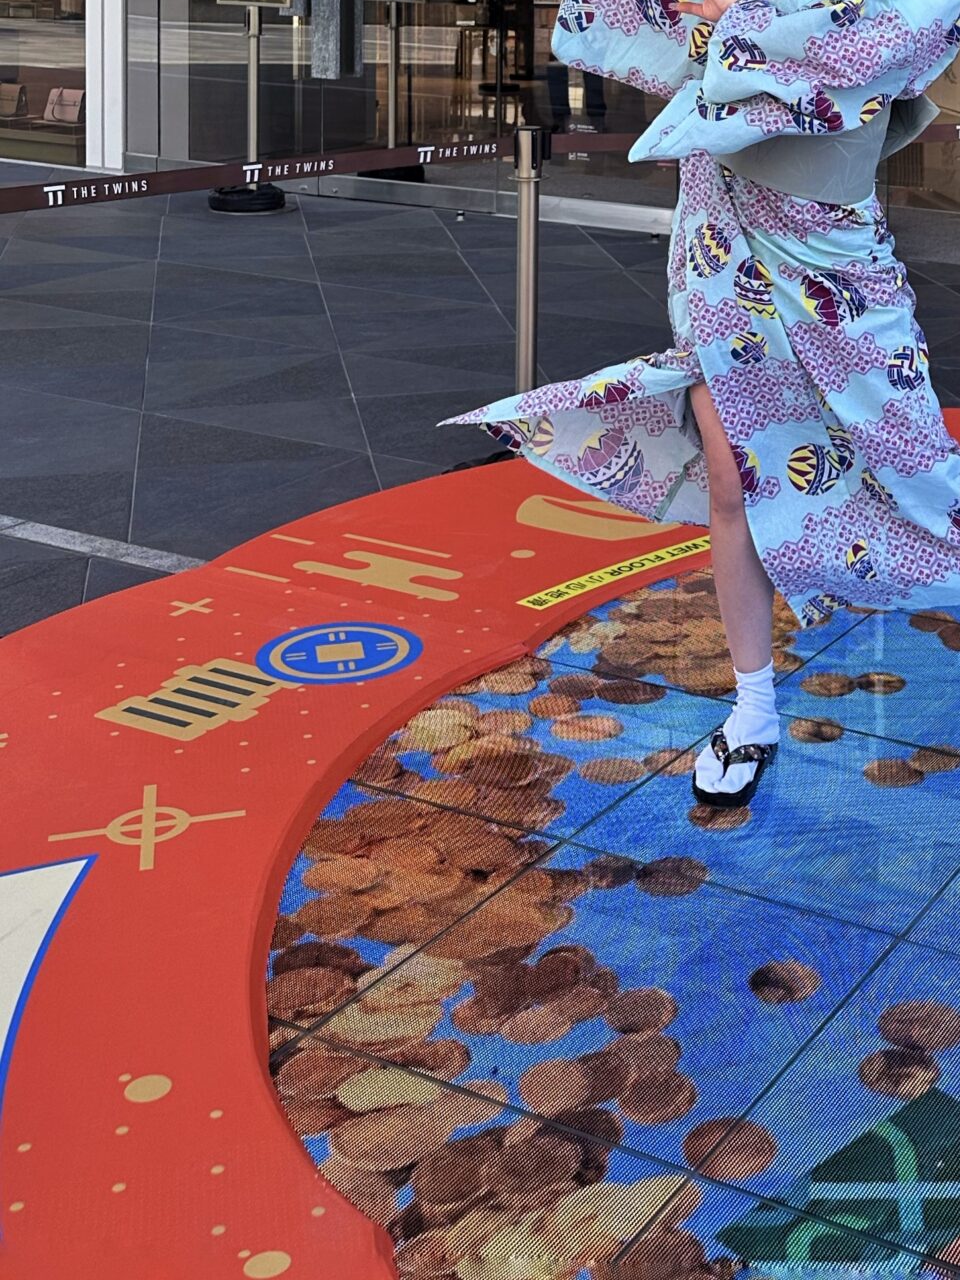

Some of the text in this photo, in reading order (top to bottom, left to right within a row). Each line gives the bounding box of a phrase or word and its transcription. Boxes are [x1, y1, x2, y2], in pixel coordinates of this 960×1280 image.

[439, 147, 458, 159] THE
[463, 143, 497, 156] TWINS
[267, 164, 289, 177] THE
[296, 159, 335, 175] TWINS
[71, 185, 97, 199] THE
[104, 180, 148, 195] TWINS
[665, 542, 706, 558] WET
[608, 554, 667, 577] FLOOR
